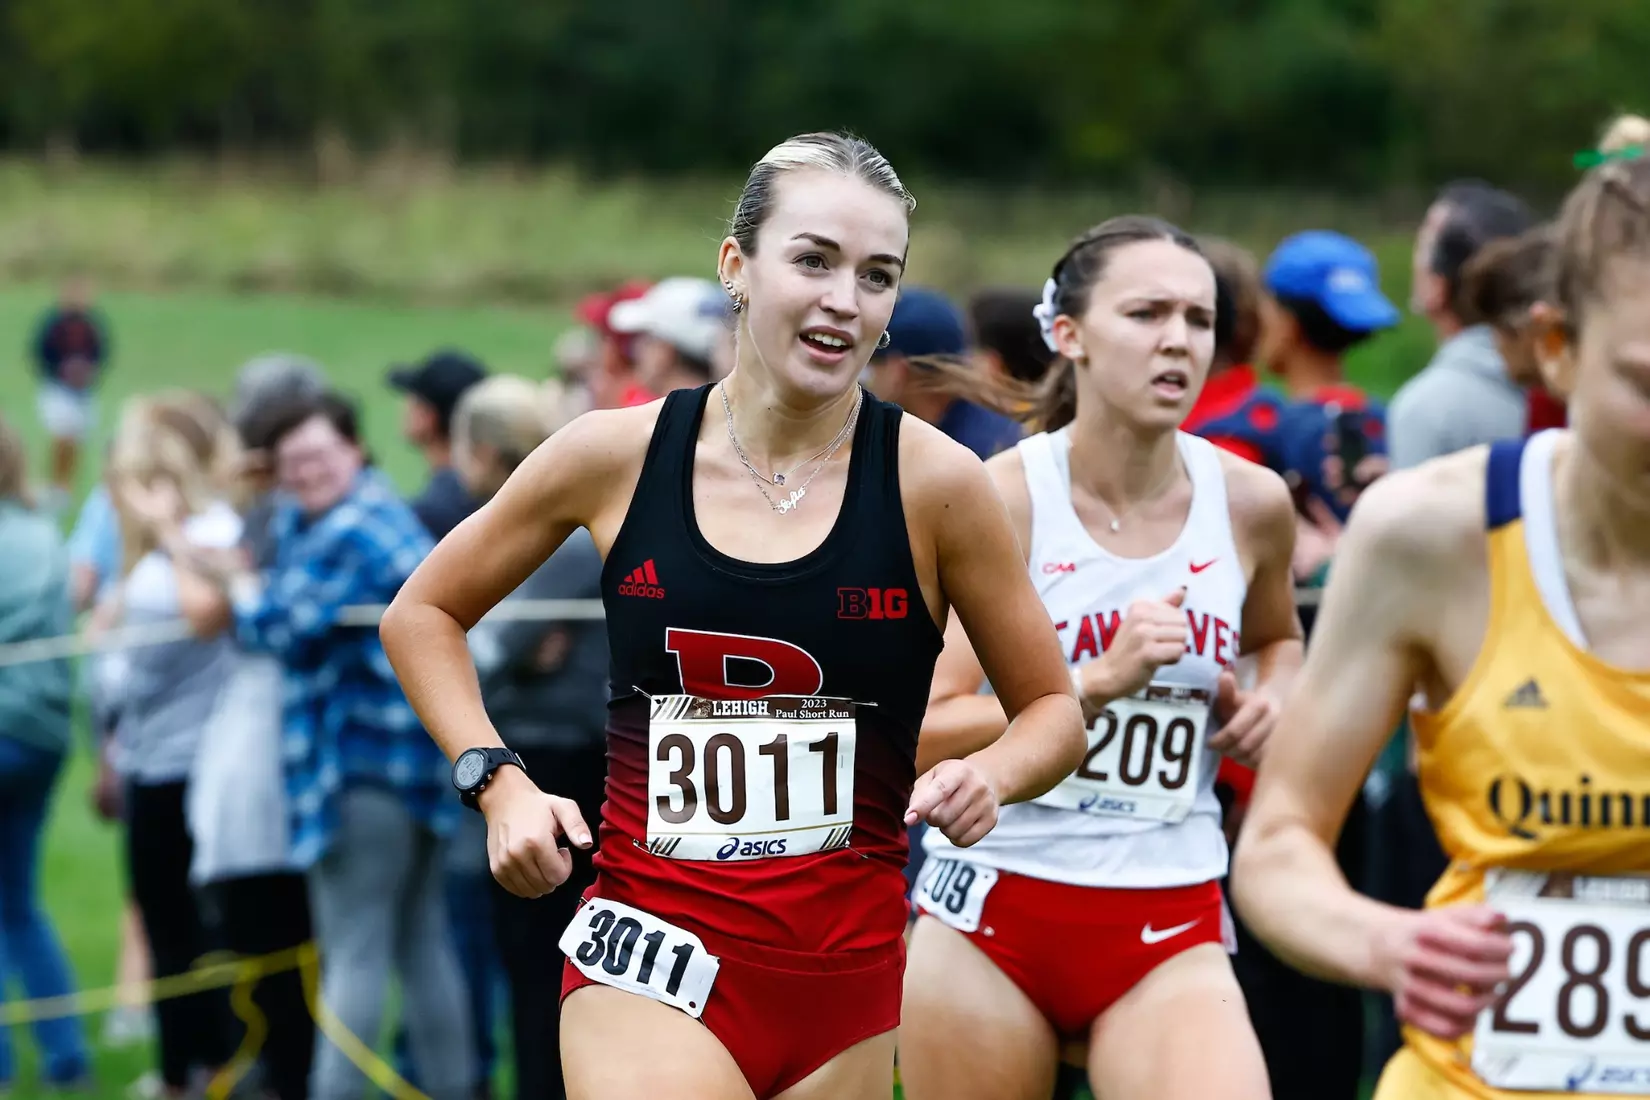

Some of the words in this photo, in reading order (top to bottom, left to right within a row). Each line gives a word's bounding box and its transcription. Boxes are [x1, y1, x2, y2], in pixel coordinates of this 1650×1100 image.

[618, 583, 665, 599] adidas
[712, 700, 771, 716] LEHIGH
[801, 699, 827, 708] 2023
[775, 709, 797, 718] Paul
[799, 709, 826, 718] Short
[829, 708, 850, 718] Run
[1077, 709, 1196, 790] 209
[656, 732, 839, 825] 3011
[1488, 771, 1650, 841] Quin
[740, 839, 787, 856] asics
[576, 909, 695, 997] 3011
